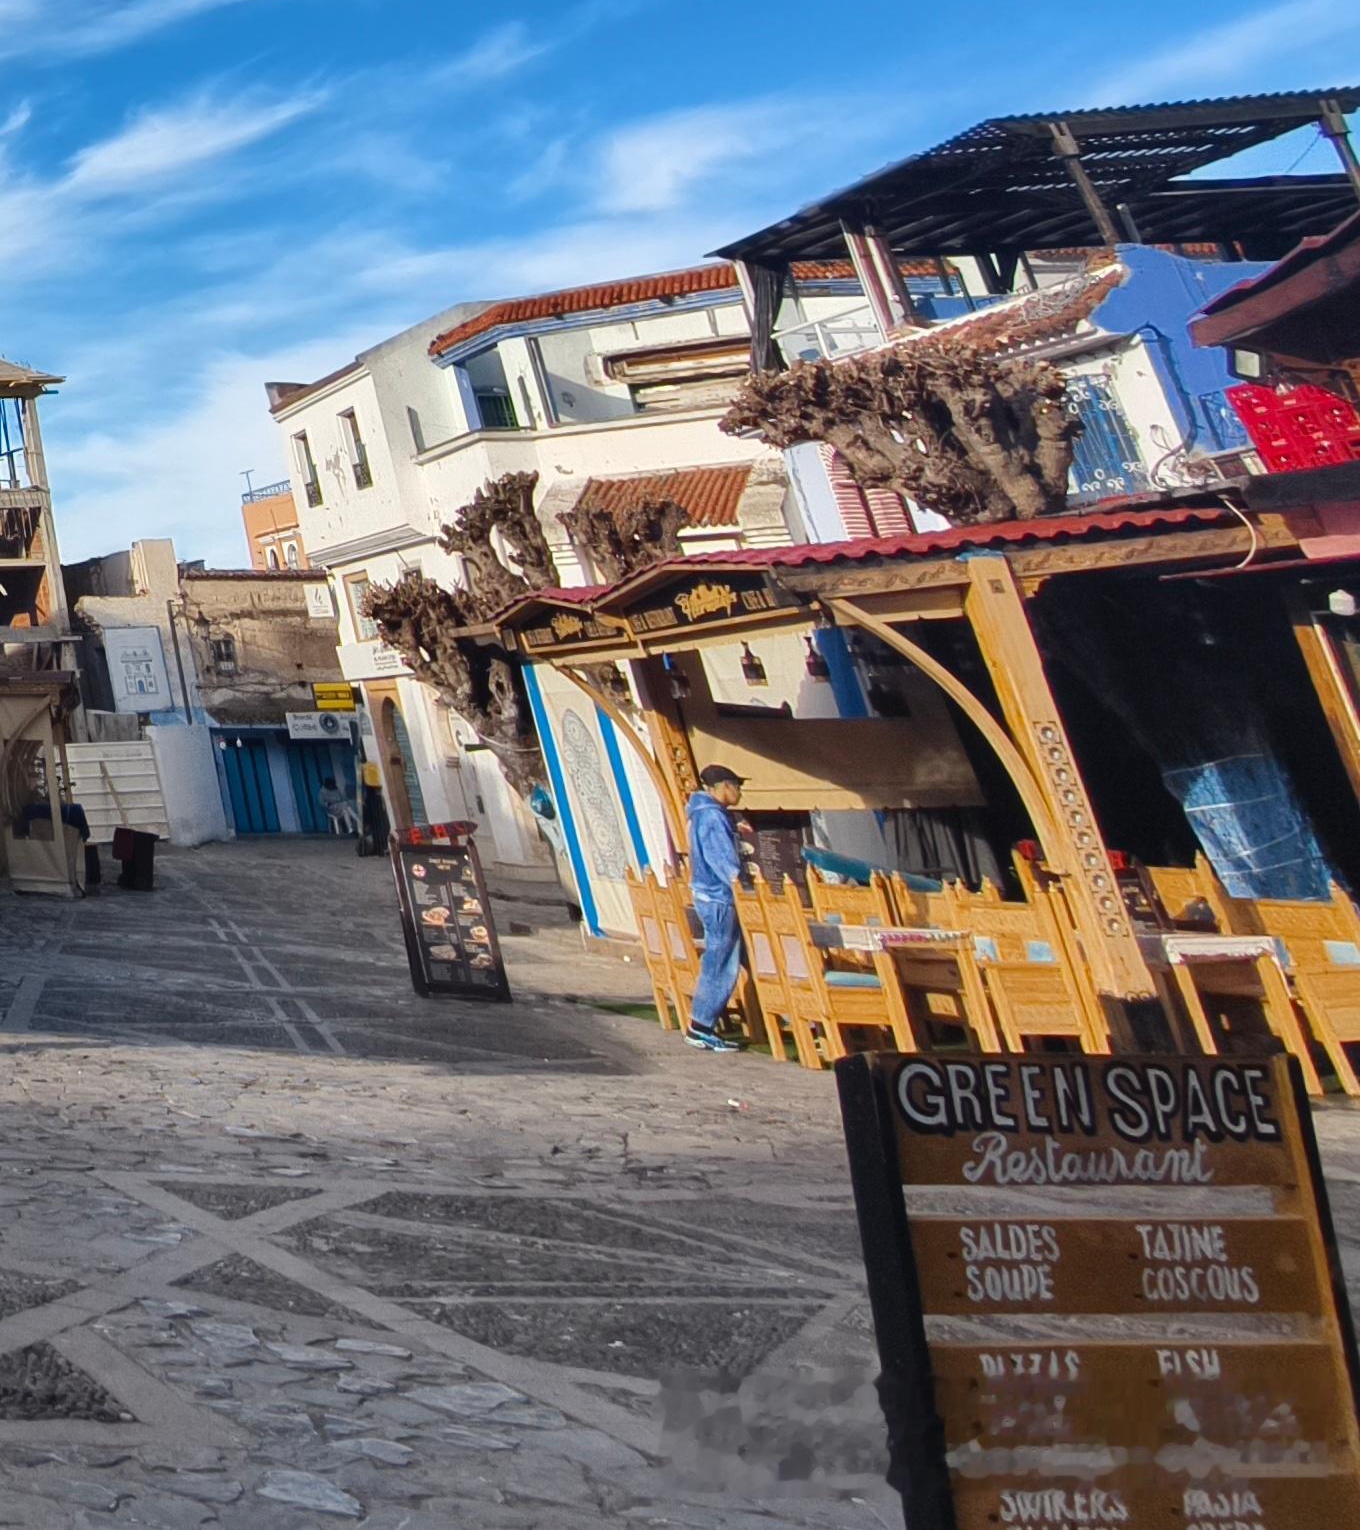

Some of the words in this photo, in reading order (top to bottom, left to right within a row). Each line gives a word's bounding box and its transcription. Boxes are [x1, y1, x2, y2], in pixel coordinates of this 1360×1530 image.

[896, 1061, 1092, 1128] GREEN
[1105, 1067, 1277, 1139] SPACE
[962, 1131, 1215, 1185] Restaurant
[960, 1222, 1061, 1263] SALDES
[1134, 1223, 1228, 1263] TAJINE
[965, 1264, 1054, 1302] SOUPE
[1142, 1265, 1260, 1304] COSCOUS
